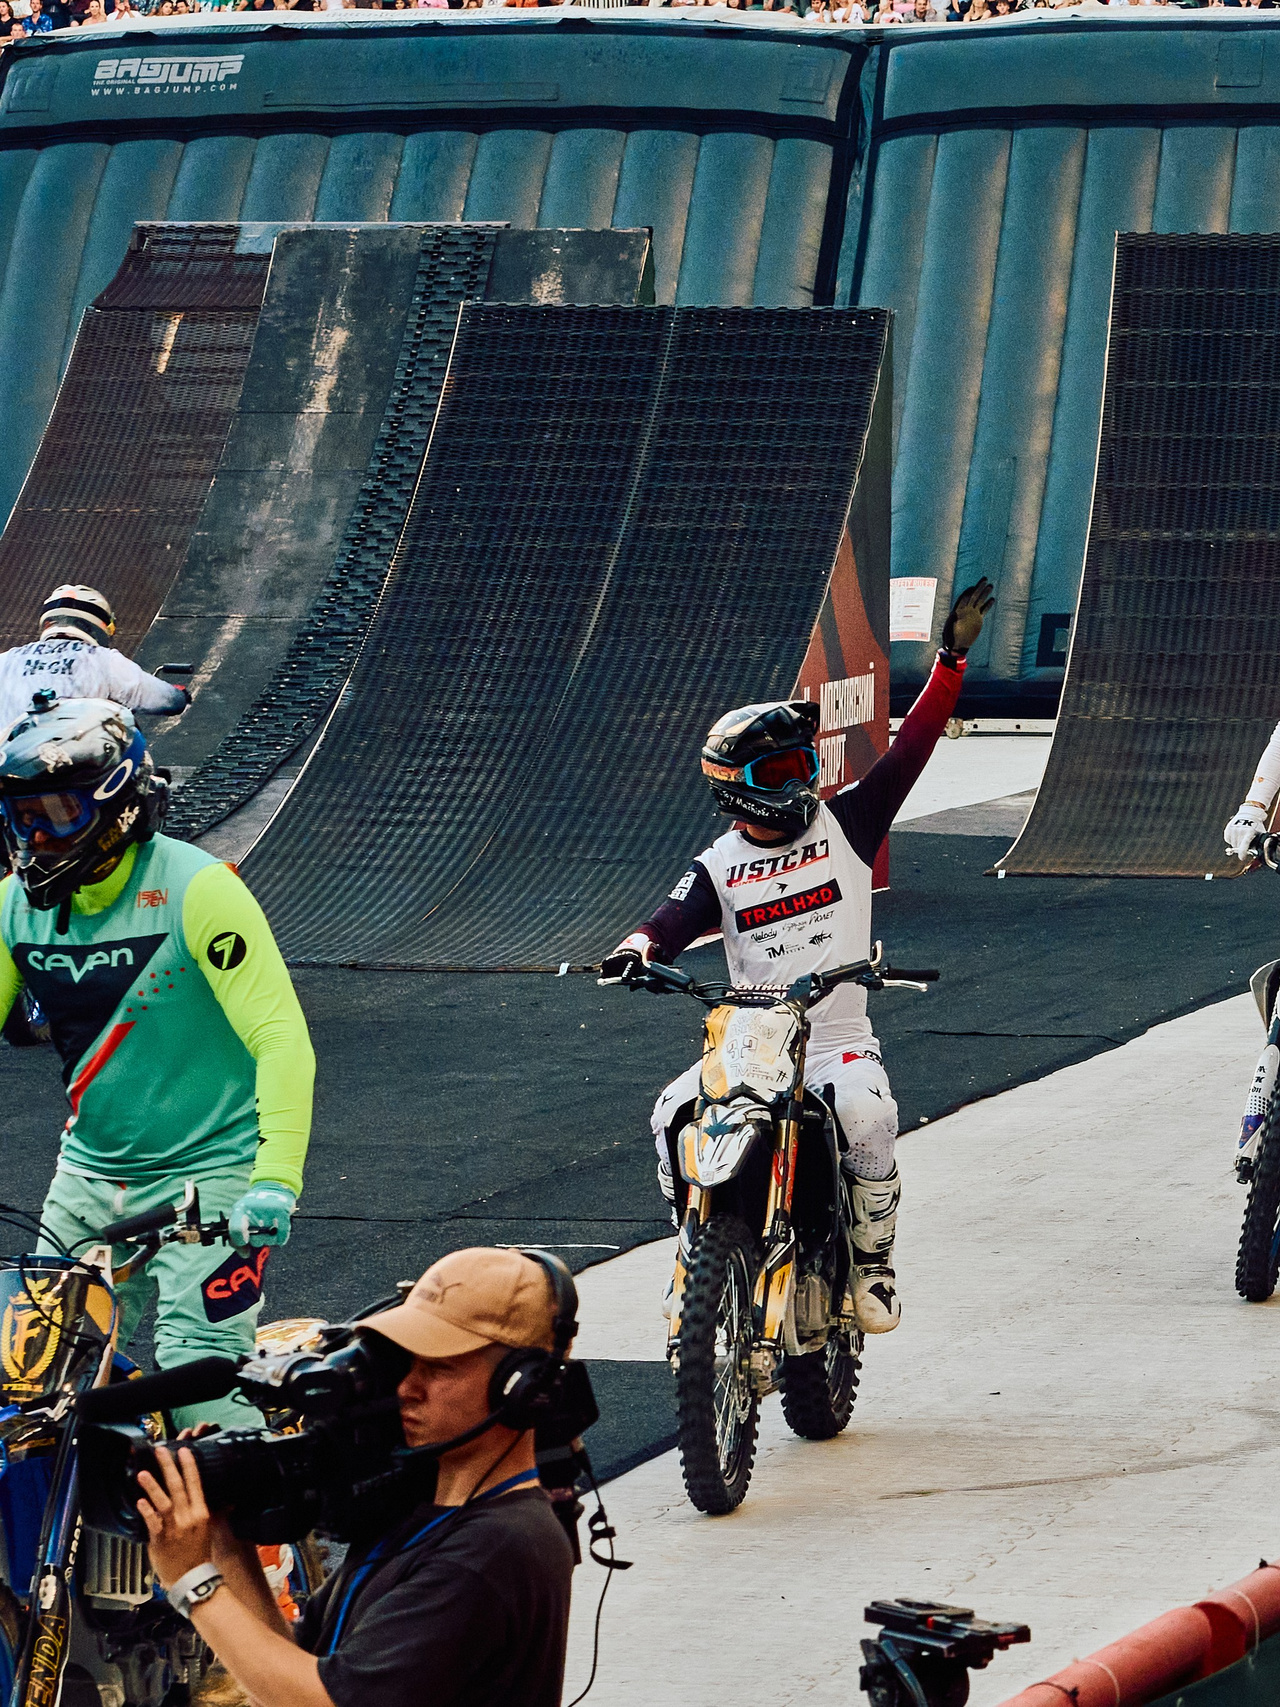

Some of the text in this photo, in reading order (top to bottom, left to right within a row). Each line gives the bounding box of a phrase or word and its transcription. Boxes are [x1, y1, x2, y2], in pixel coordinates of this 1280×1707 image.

[94, 54, 245, 84] BAGJUMP
[819, 661, 875, 730] МОСКОВСКИЙ
[819, 733, 847, 789] СПОРТ
[1234, 819, 1255, 827] FK
[741, 886, 833, 927] TRXLHXD
[24, 1614, 67, 1707] ENDA
